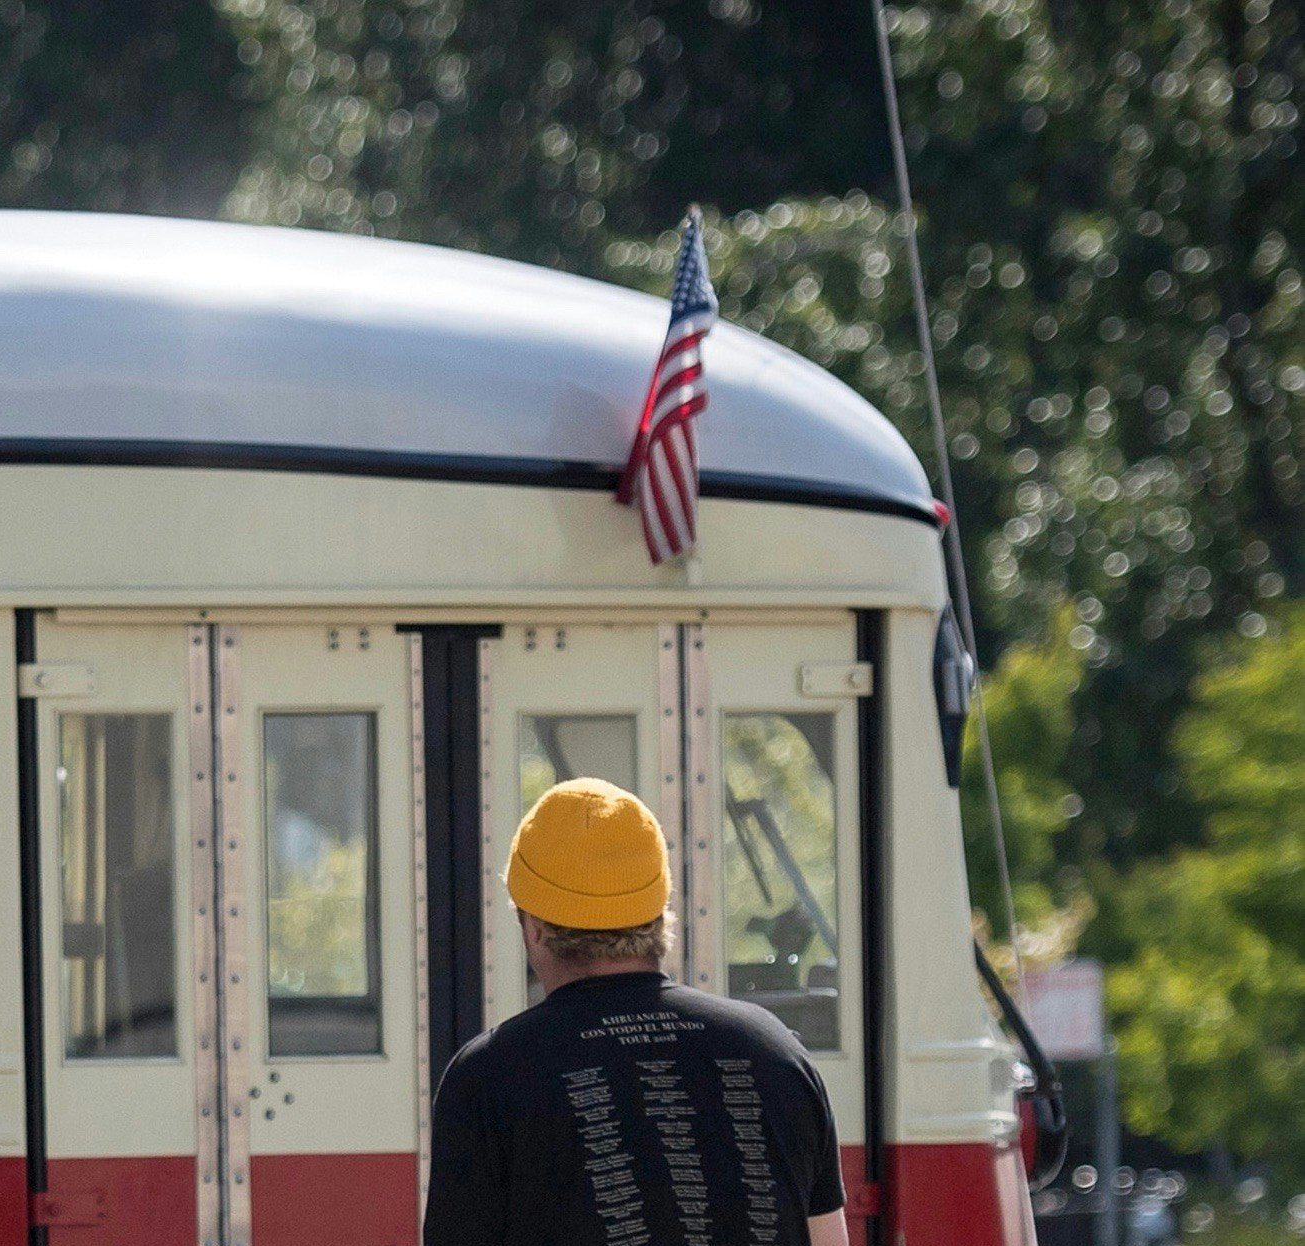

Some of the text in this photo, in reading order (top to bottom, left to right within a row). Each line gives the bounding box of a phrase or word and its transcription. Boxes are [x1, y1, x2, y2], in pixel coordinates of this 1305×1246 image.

[580, 1021, 705, 1040] CON TODO EL MUNDO
[618, 1034, 651, 1045] TOUR
